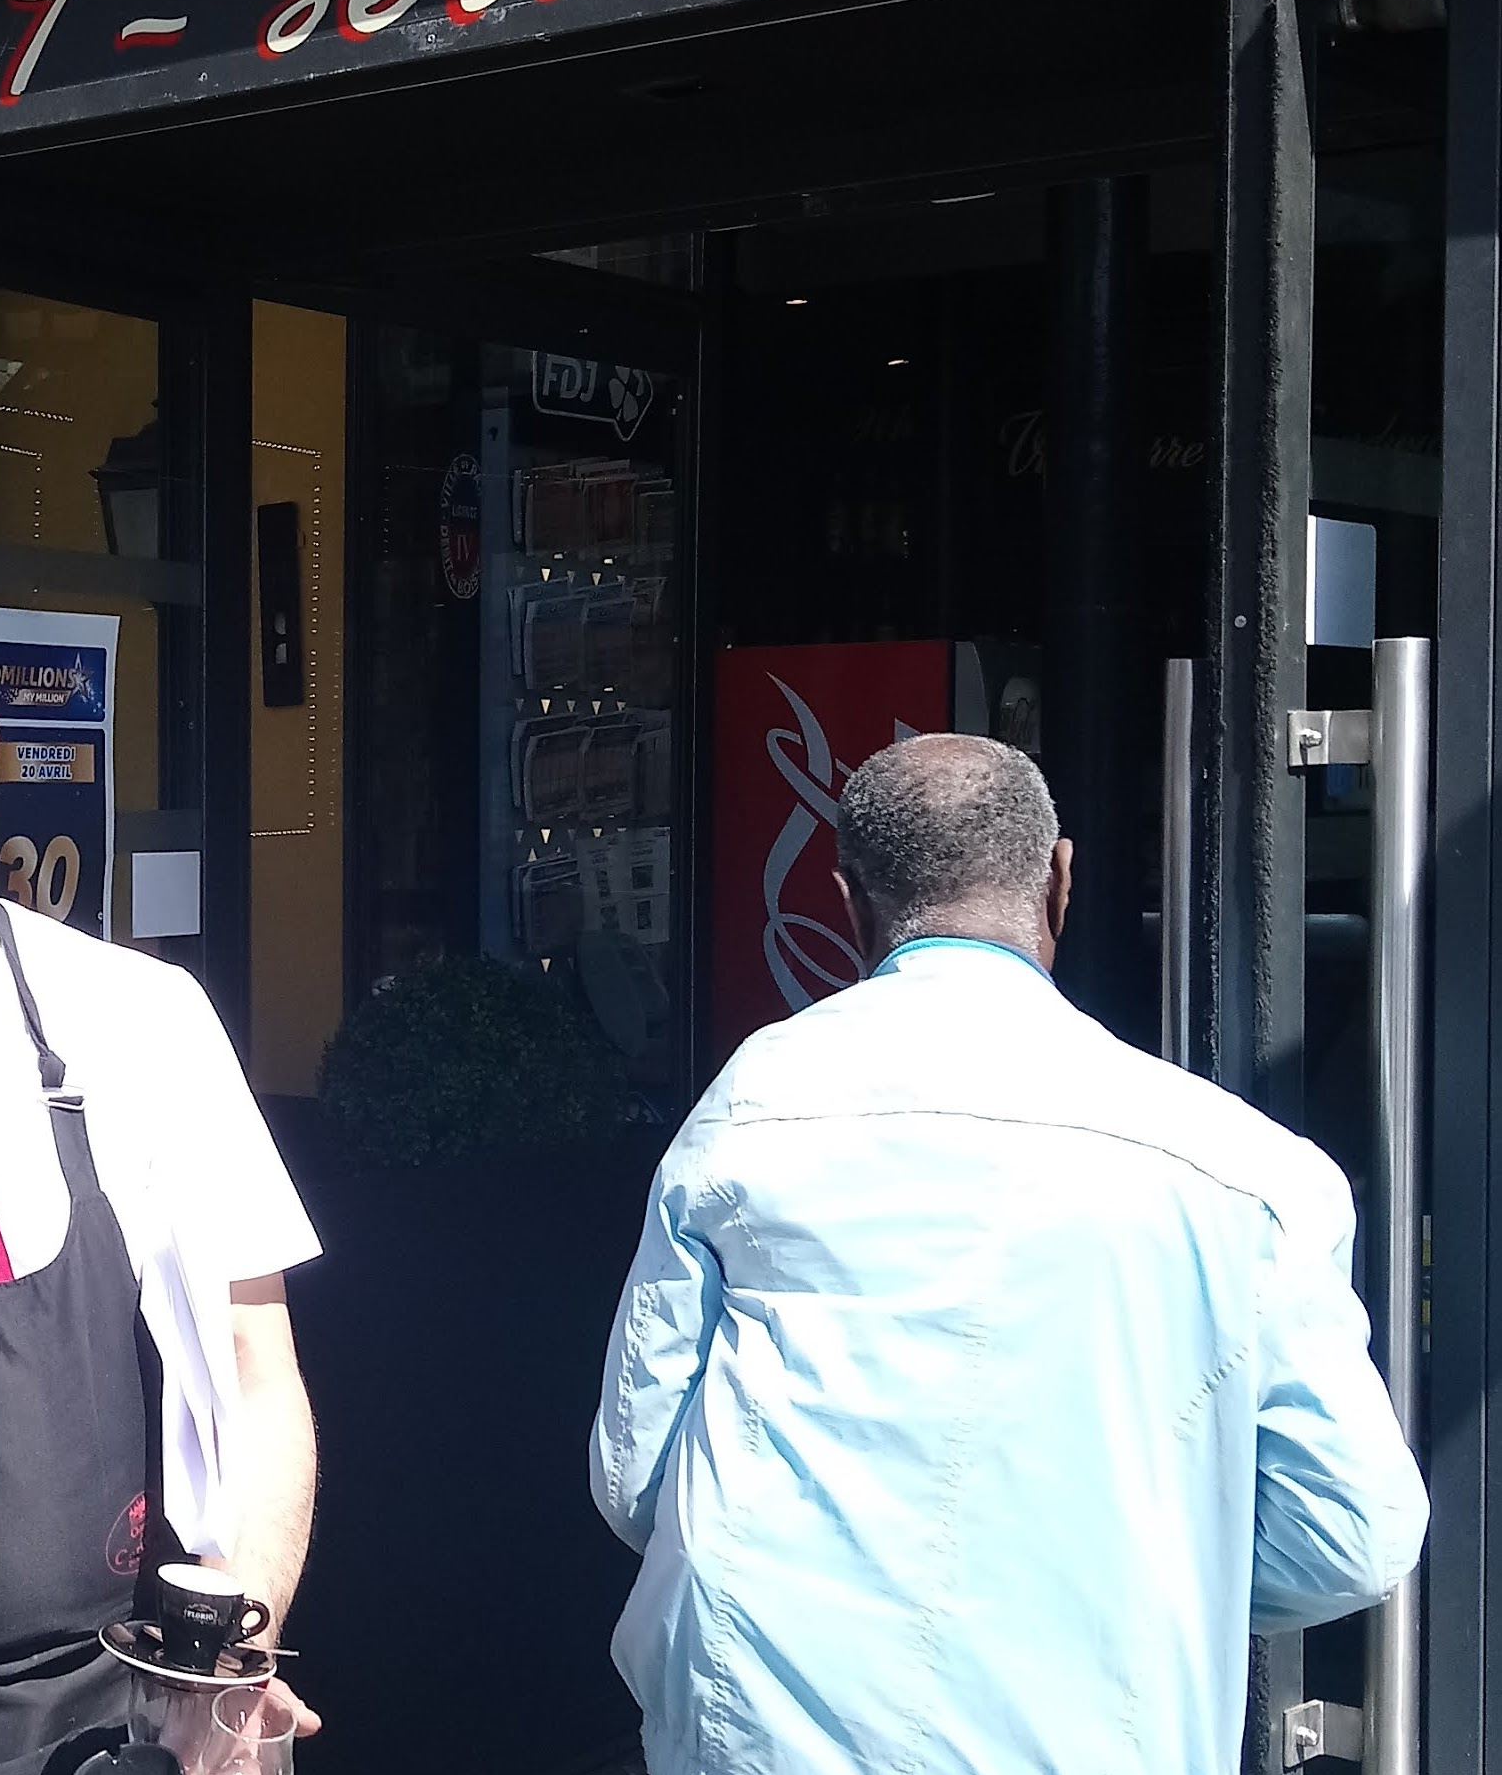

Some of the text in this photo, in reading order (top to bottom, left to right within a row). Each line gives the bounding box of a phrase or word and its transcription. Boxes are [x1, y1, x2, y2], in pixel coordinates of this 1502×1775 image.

[542, 353, 598, 403] FDJ
[16, 744, 76, 762] VENDREDI
[21, 764, 72, 780] 20 AVRIL
